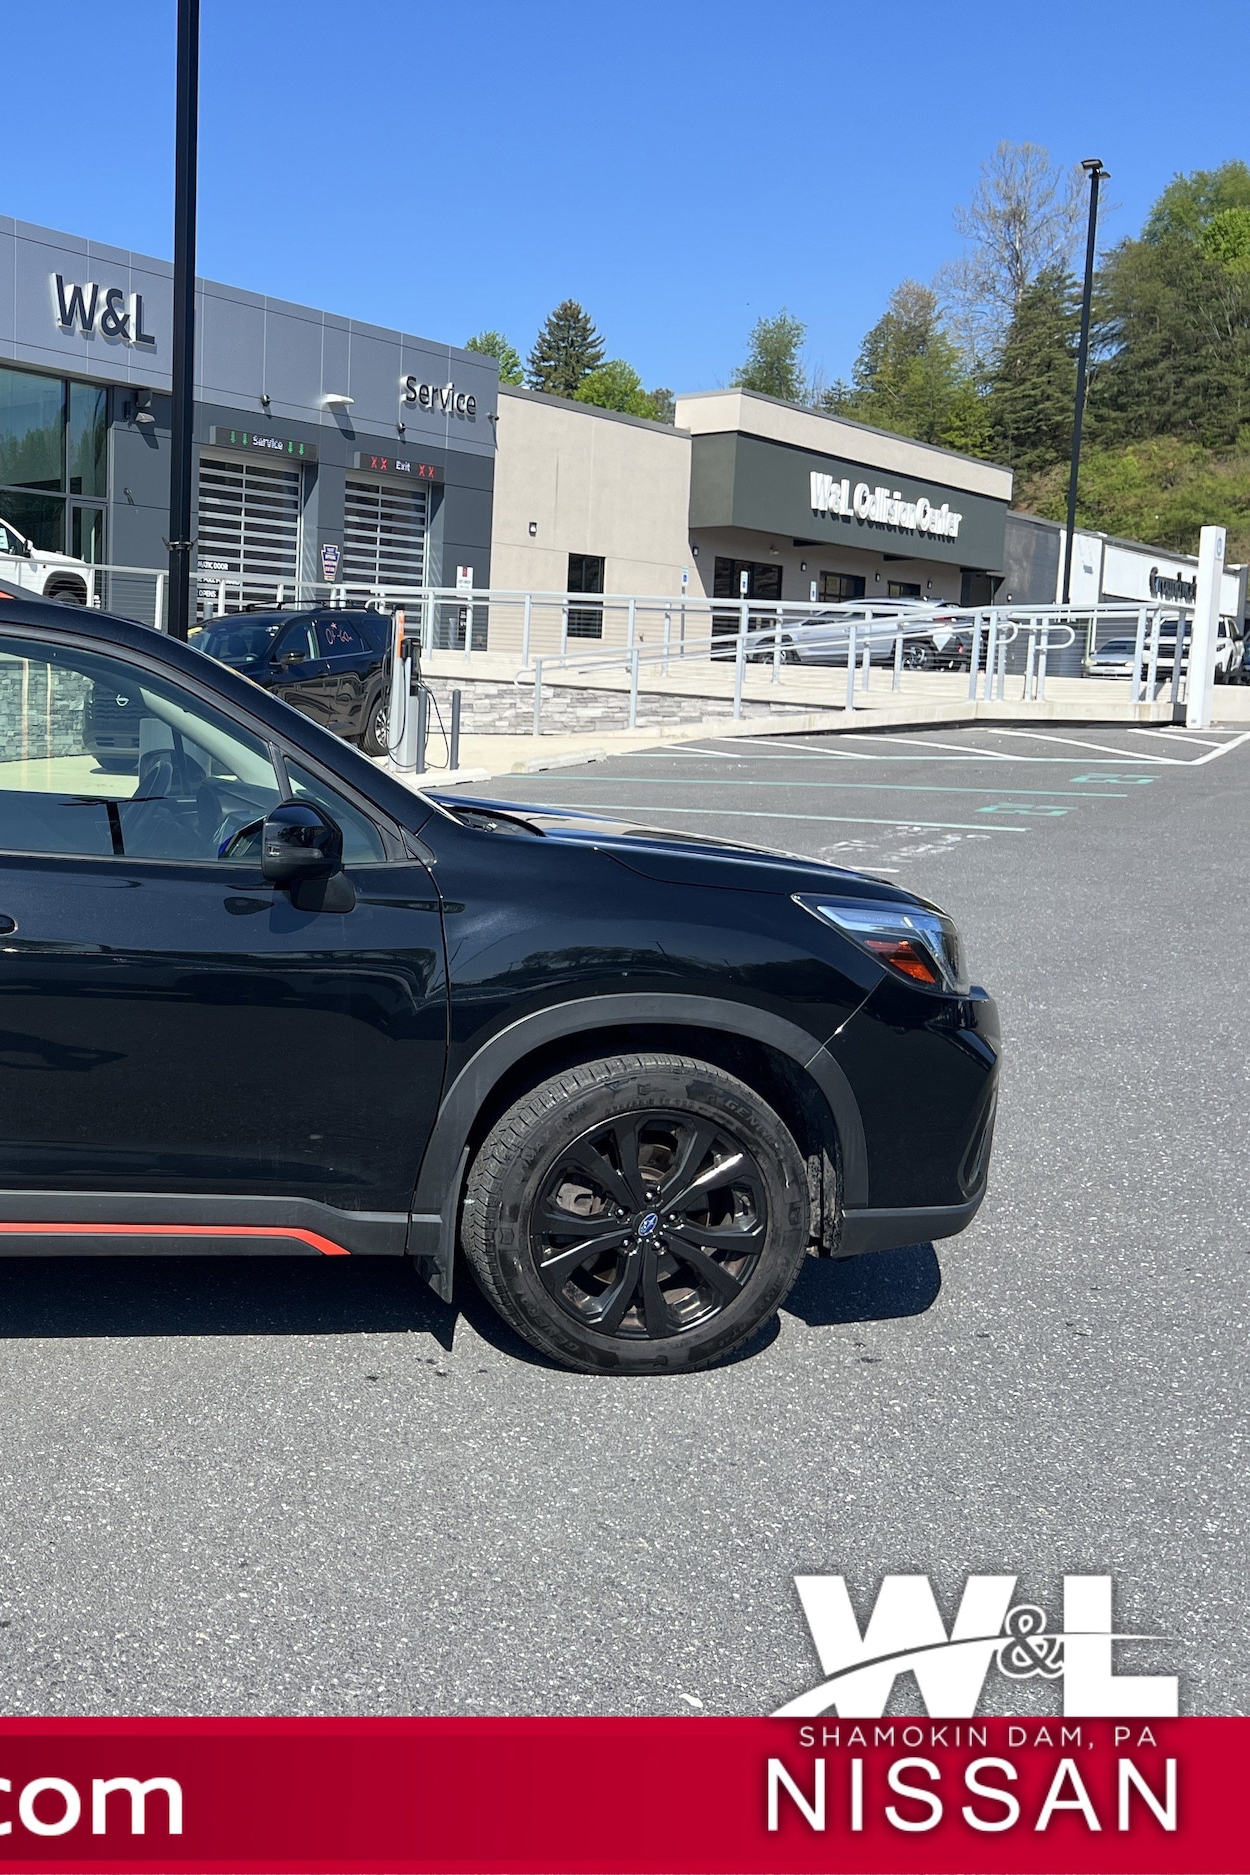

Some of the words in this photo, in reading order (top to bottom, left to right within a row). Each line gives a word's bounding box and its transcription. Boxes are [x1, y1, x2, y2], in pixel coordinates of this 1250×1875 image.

[50, 272, 156, 345] W&L
[401, 375, 476, 415] Service
[252, 435, 284, 450] Service
[395, 461, 411, 472] Exit
[810, 471, 854, 516] W&L
[853, 483, 917, 529] Collision
[916, 497, 963, 537] Center
[213, 562, 229, 570] DOOR
